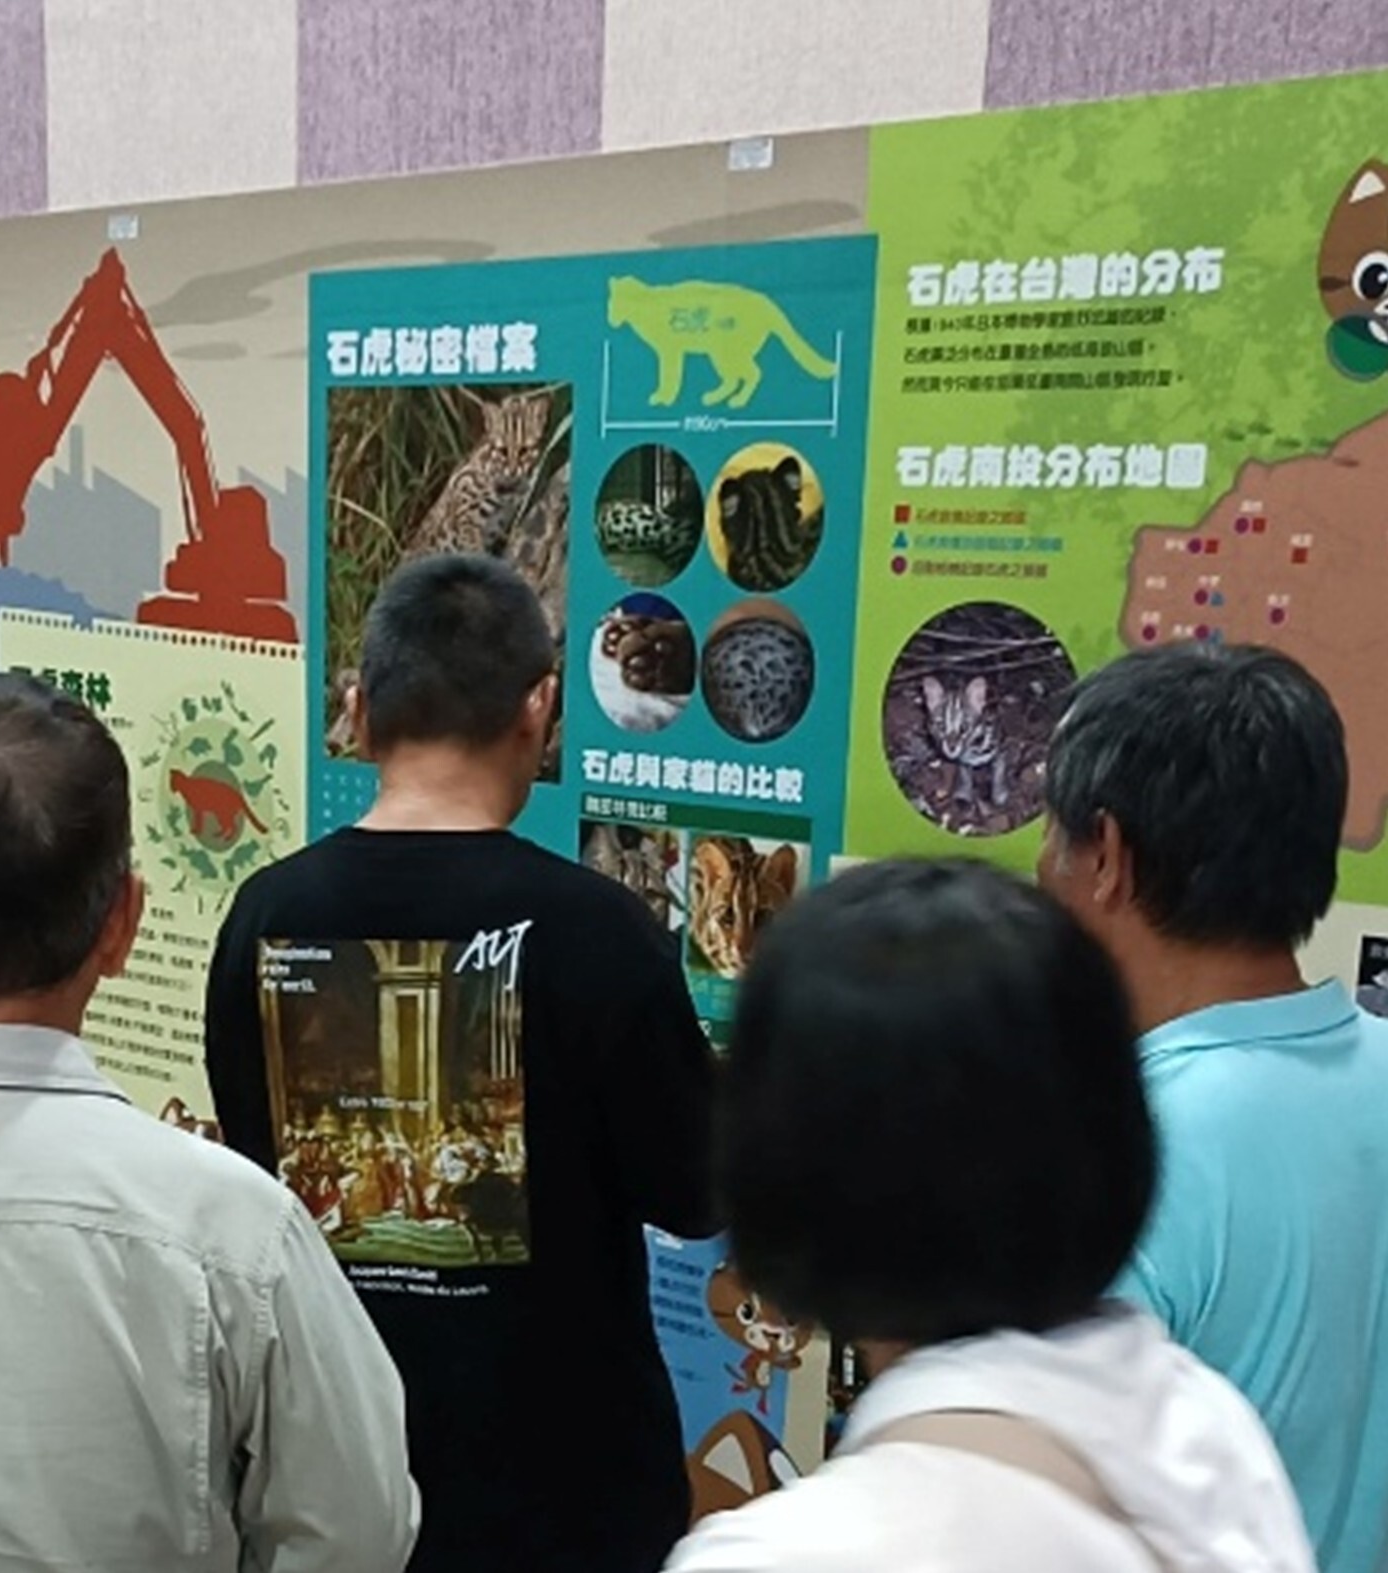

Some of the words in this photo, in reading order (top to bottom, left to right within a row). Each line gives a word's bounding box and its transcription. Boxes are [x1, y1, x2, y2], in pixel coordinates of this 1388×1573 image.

[906, 246, 1225, 307] 石虎在台灣的分布
[326, 321, 539, 377] 石虎秘密檔案
[896, 443, 1208, 488] 石虎南投分布地圖
[582, 750, 804, 803] 石虎與家貓的比較
